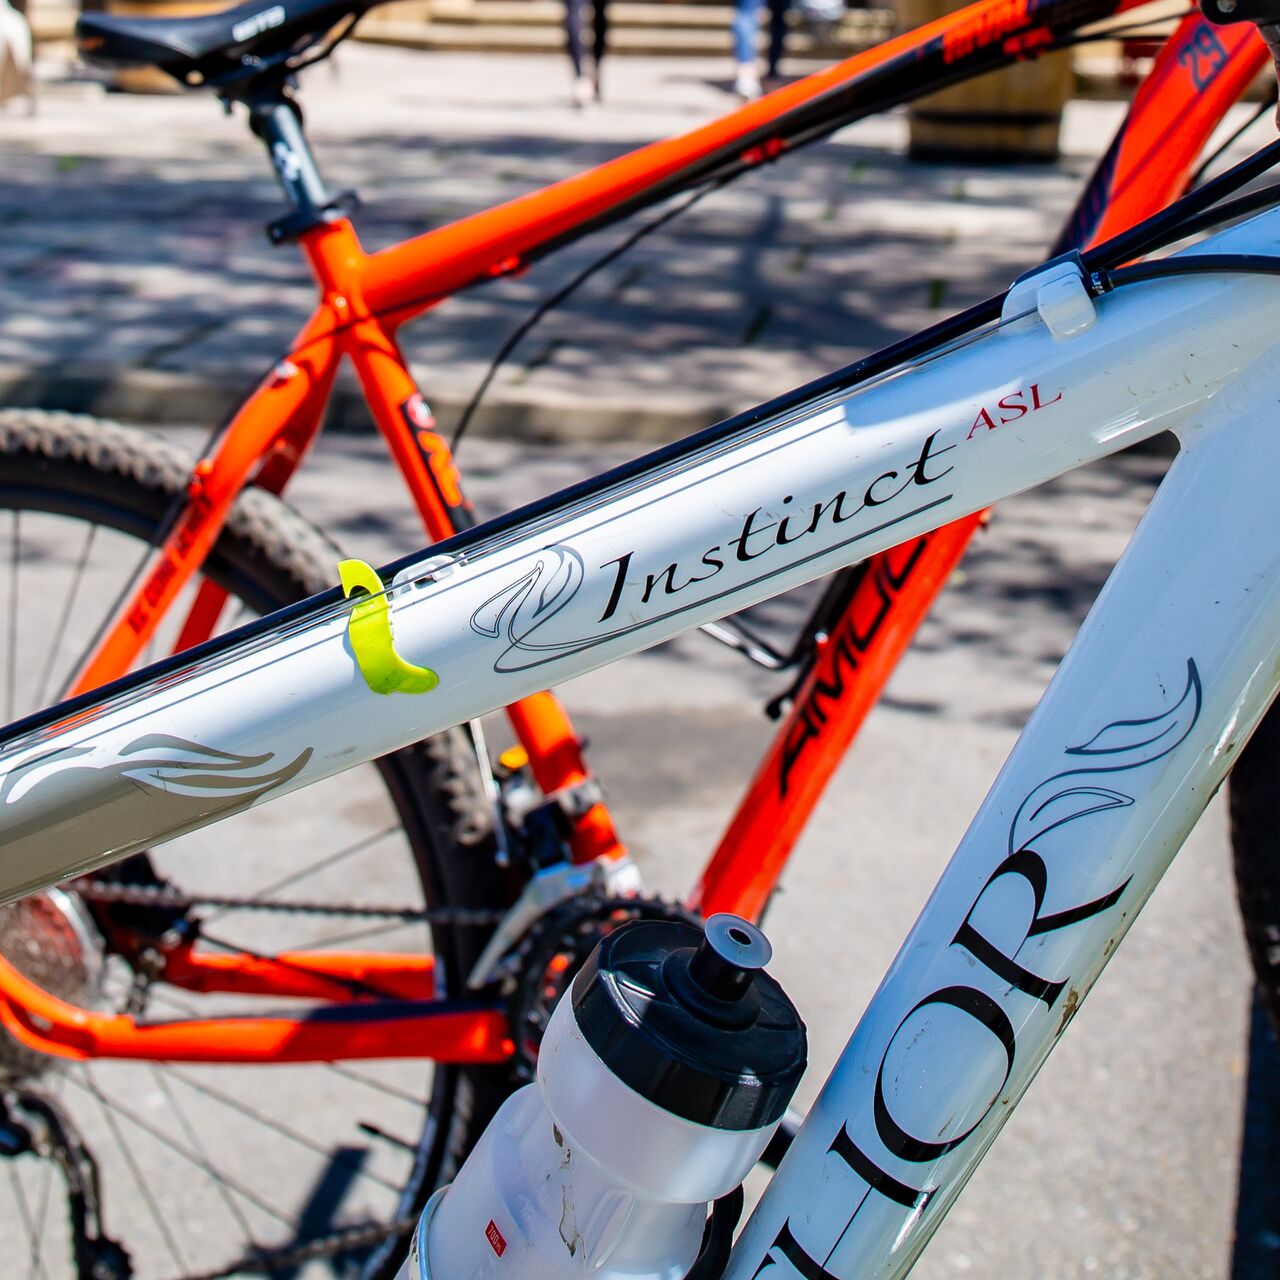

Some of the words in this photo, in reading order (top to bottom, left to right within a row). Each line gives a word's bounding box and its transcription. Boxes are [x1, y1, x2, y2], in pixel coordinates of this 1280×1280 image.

[1177, 23, 1229, 94] 29
[966, 384, 1062, 440] ASL
[598, 429, 957, 623] Instinct
